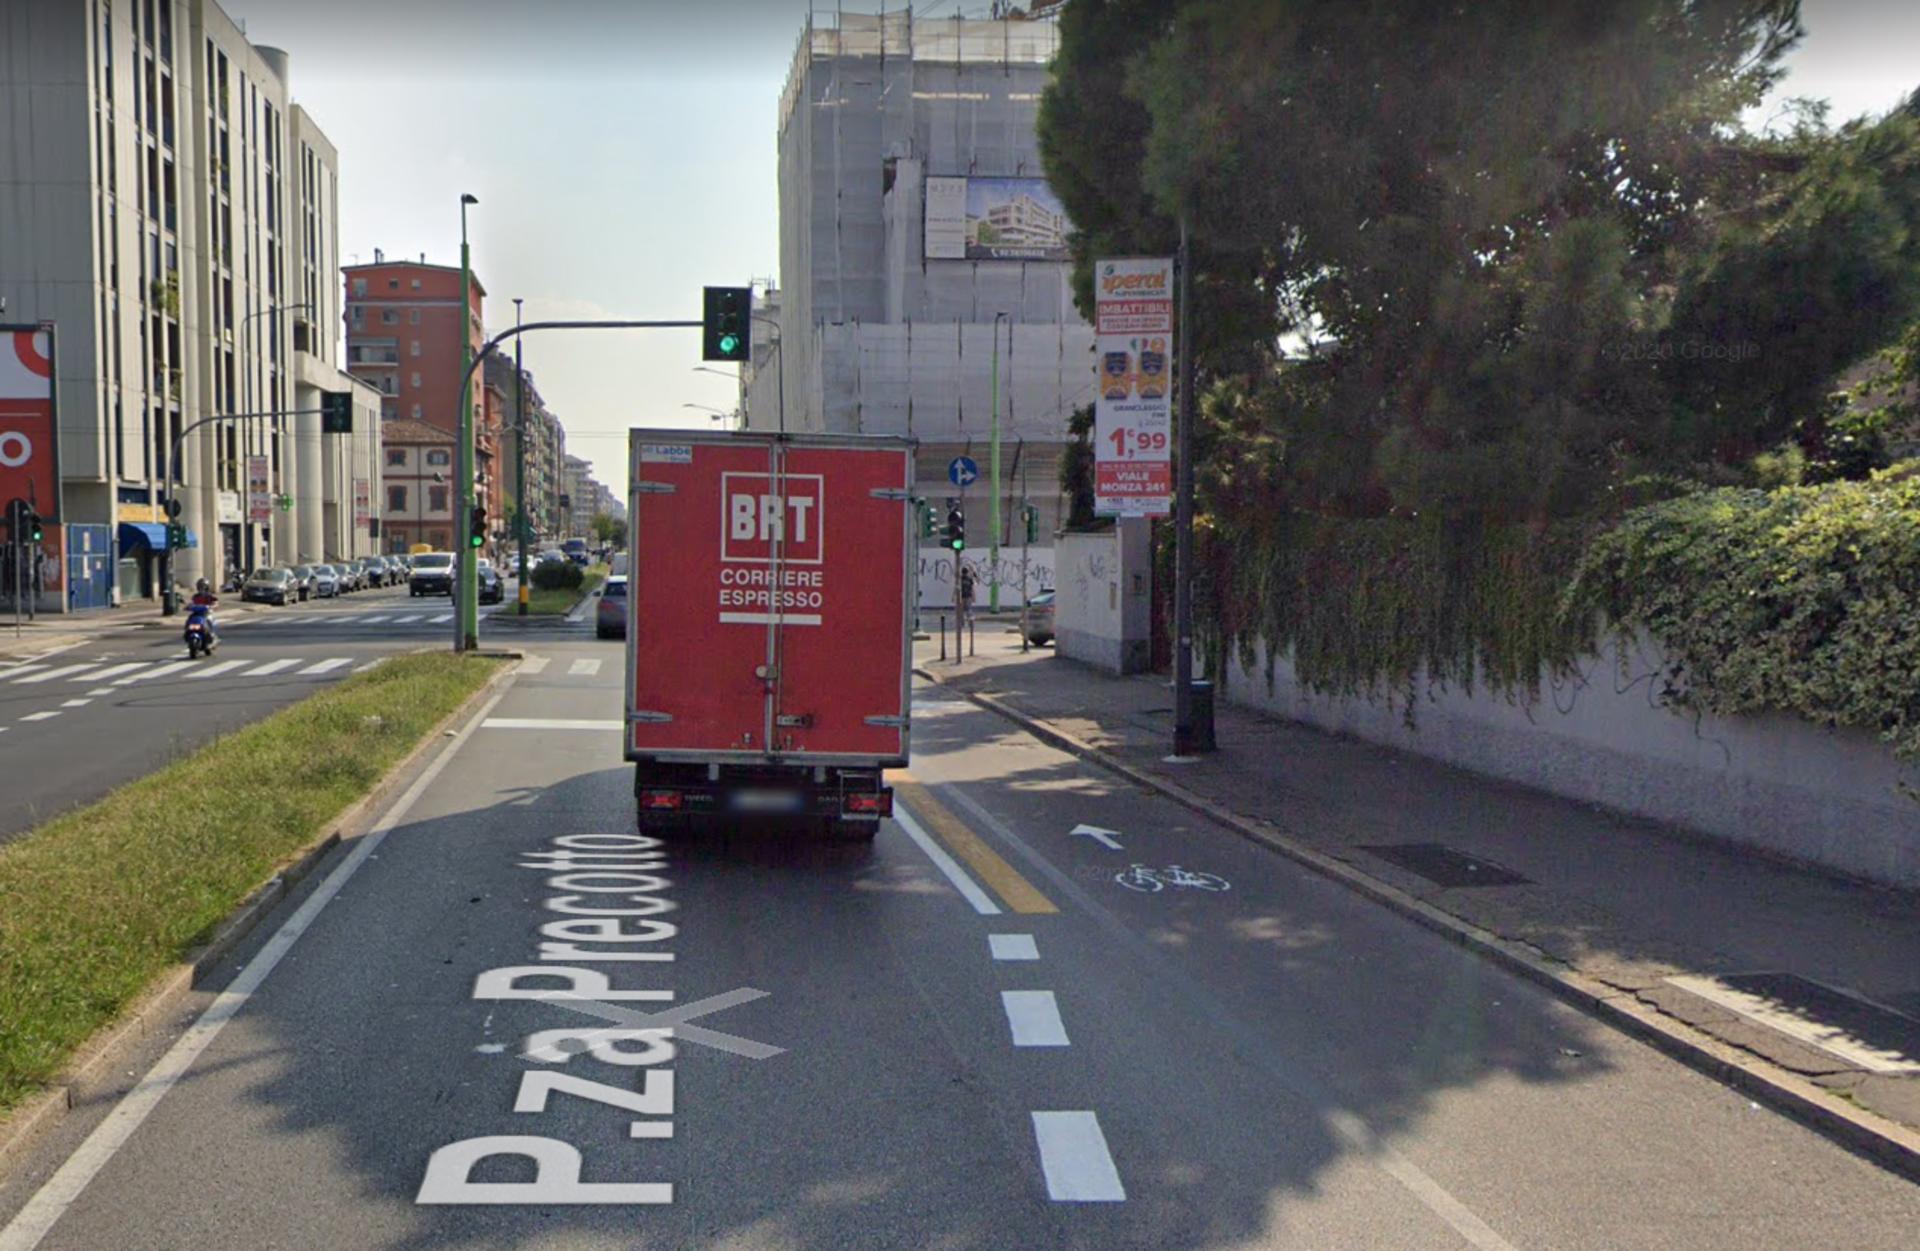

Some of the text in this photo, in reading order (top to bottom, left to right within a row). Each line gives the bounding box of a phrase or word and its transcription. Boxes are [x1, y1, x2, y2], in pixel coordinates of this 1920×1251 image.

[1099, 302, 1169, 315] IMBATTIBILI
[1116, 471, 1150, 481] VIALE
[1101, 482, 1166, 493] MONZA 241
[732, 494, 814, 543] BRT
[720, 568, 824, 588] CORRIERE
[719, 589, 823, 608] ESPRESSO
[415, 833, 679, 1204] P.za Precotto
